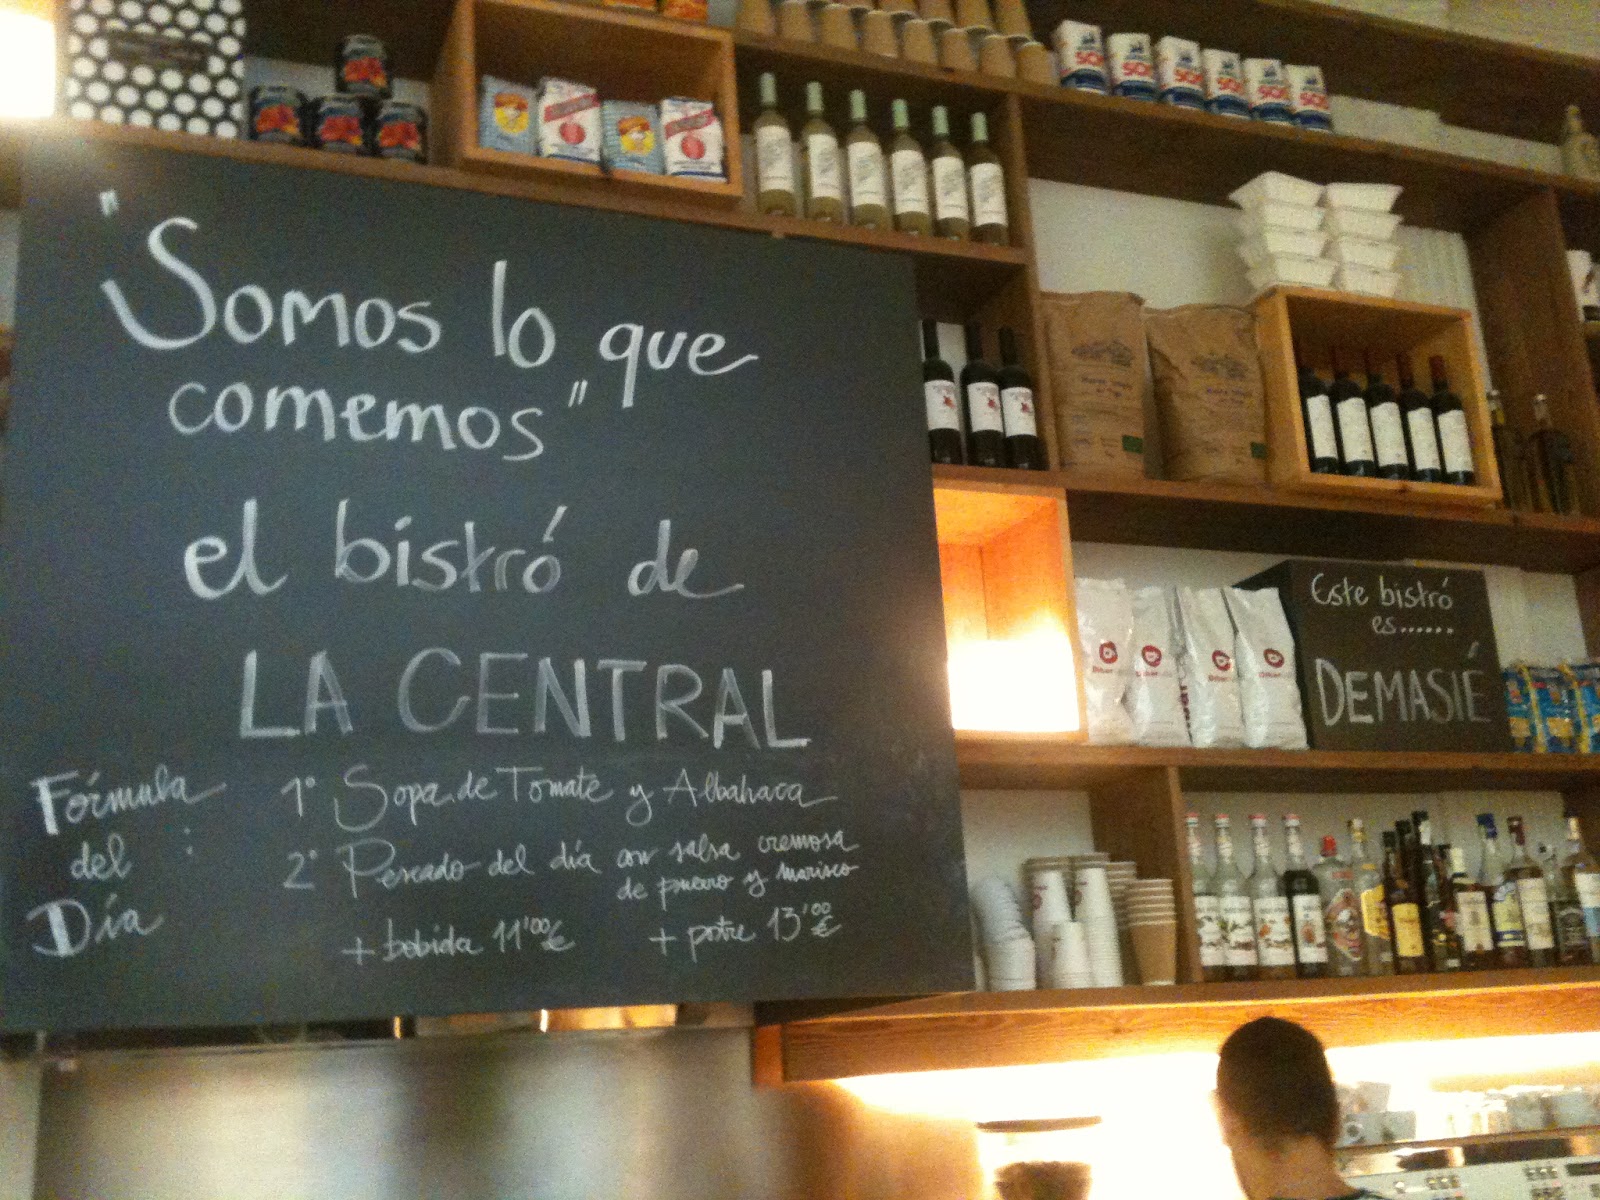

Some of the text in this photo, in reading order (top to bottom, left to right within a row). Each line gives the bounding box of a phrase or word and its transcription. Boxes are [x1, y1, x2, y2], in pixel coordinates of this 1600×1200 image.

[491, 260, 557, 369] lo
[599, 323, 759, 409] que
[183, 498, 745, 599] el bistró de
[1311, 573, 1453, 610] Este bistró
[239, 648, 812, 749] LA CENTRAL
[1315, 642, 1491, 726] DEMASIÉ
[31, 764, 227, 835] Fórmula
[459, 770, 498, 801] de
[496, 766, 614, 803] Tomate
[625, 783, 654, 827] y
[663, 768, 837, 808] Albahaca
[71, 834, 131, 880] del
[488, 843, 534, 876] del
[549, 840, 601, 874] día
[616, 848, 658, 869] con
[669, 833, 740, 864] salsa
[758, 829, 859, 853] cremosa
[616, 876, 648, 901] de
[743, 870, 768, 898] y
[27, 893, 164, 958] Día
